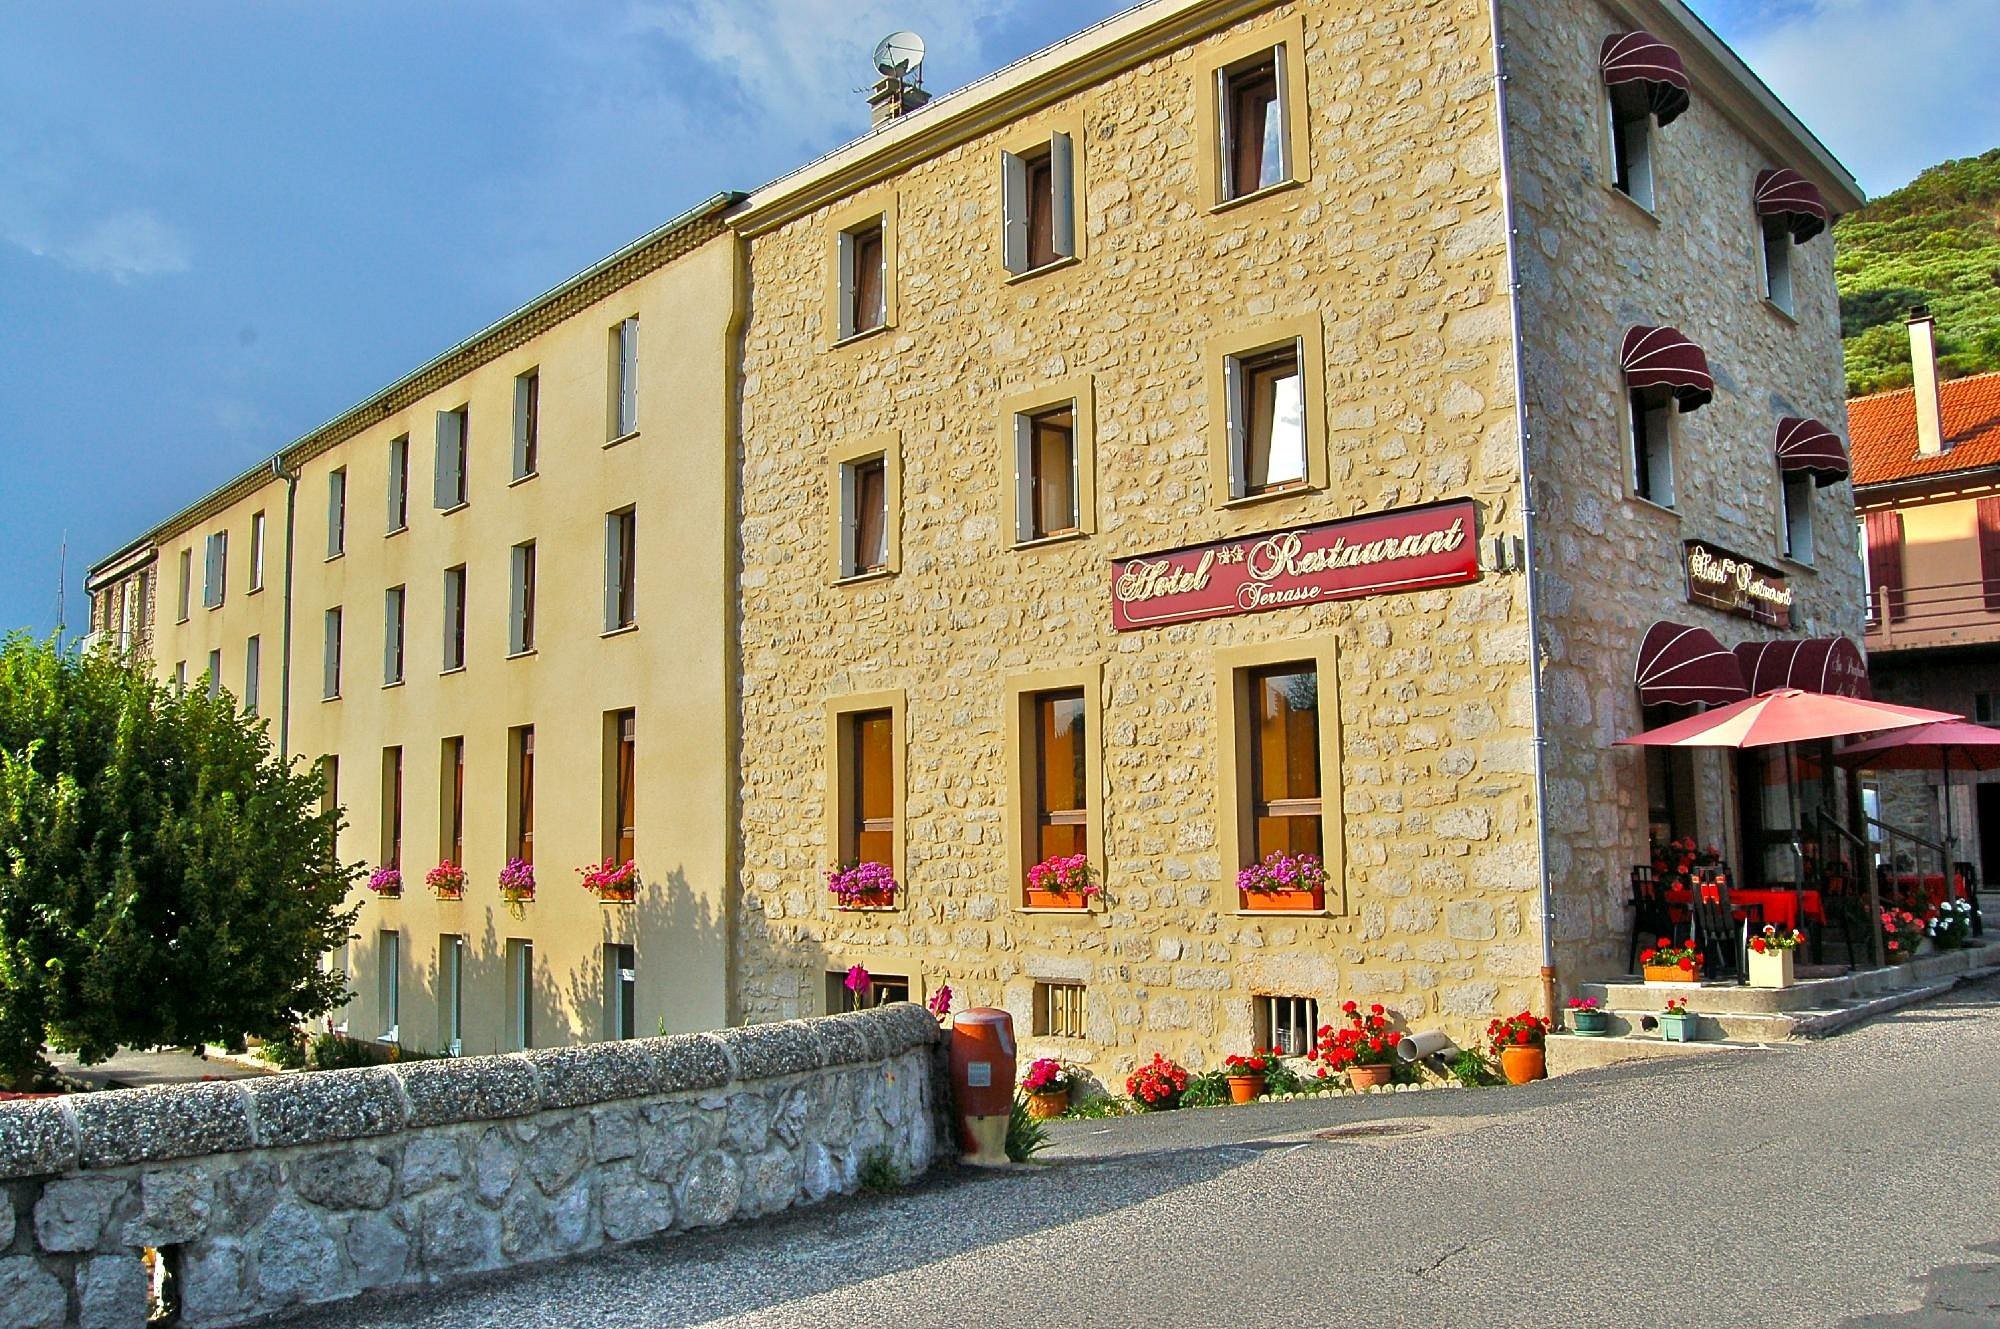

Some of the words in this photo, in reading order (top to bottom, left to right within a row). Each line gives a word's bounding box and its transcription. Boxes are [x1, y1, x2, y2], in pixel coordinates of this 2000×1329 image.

[1247, 518, 1466, 580] Restaurant
[1236, 582, 1322, 610] Terrasse
[1736, 563, 1792, 606] Restaurant
